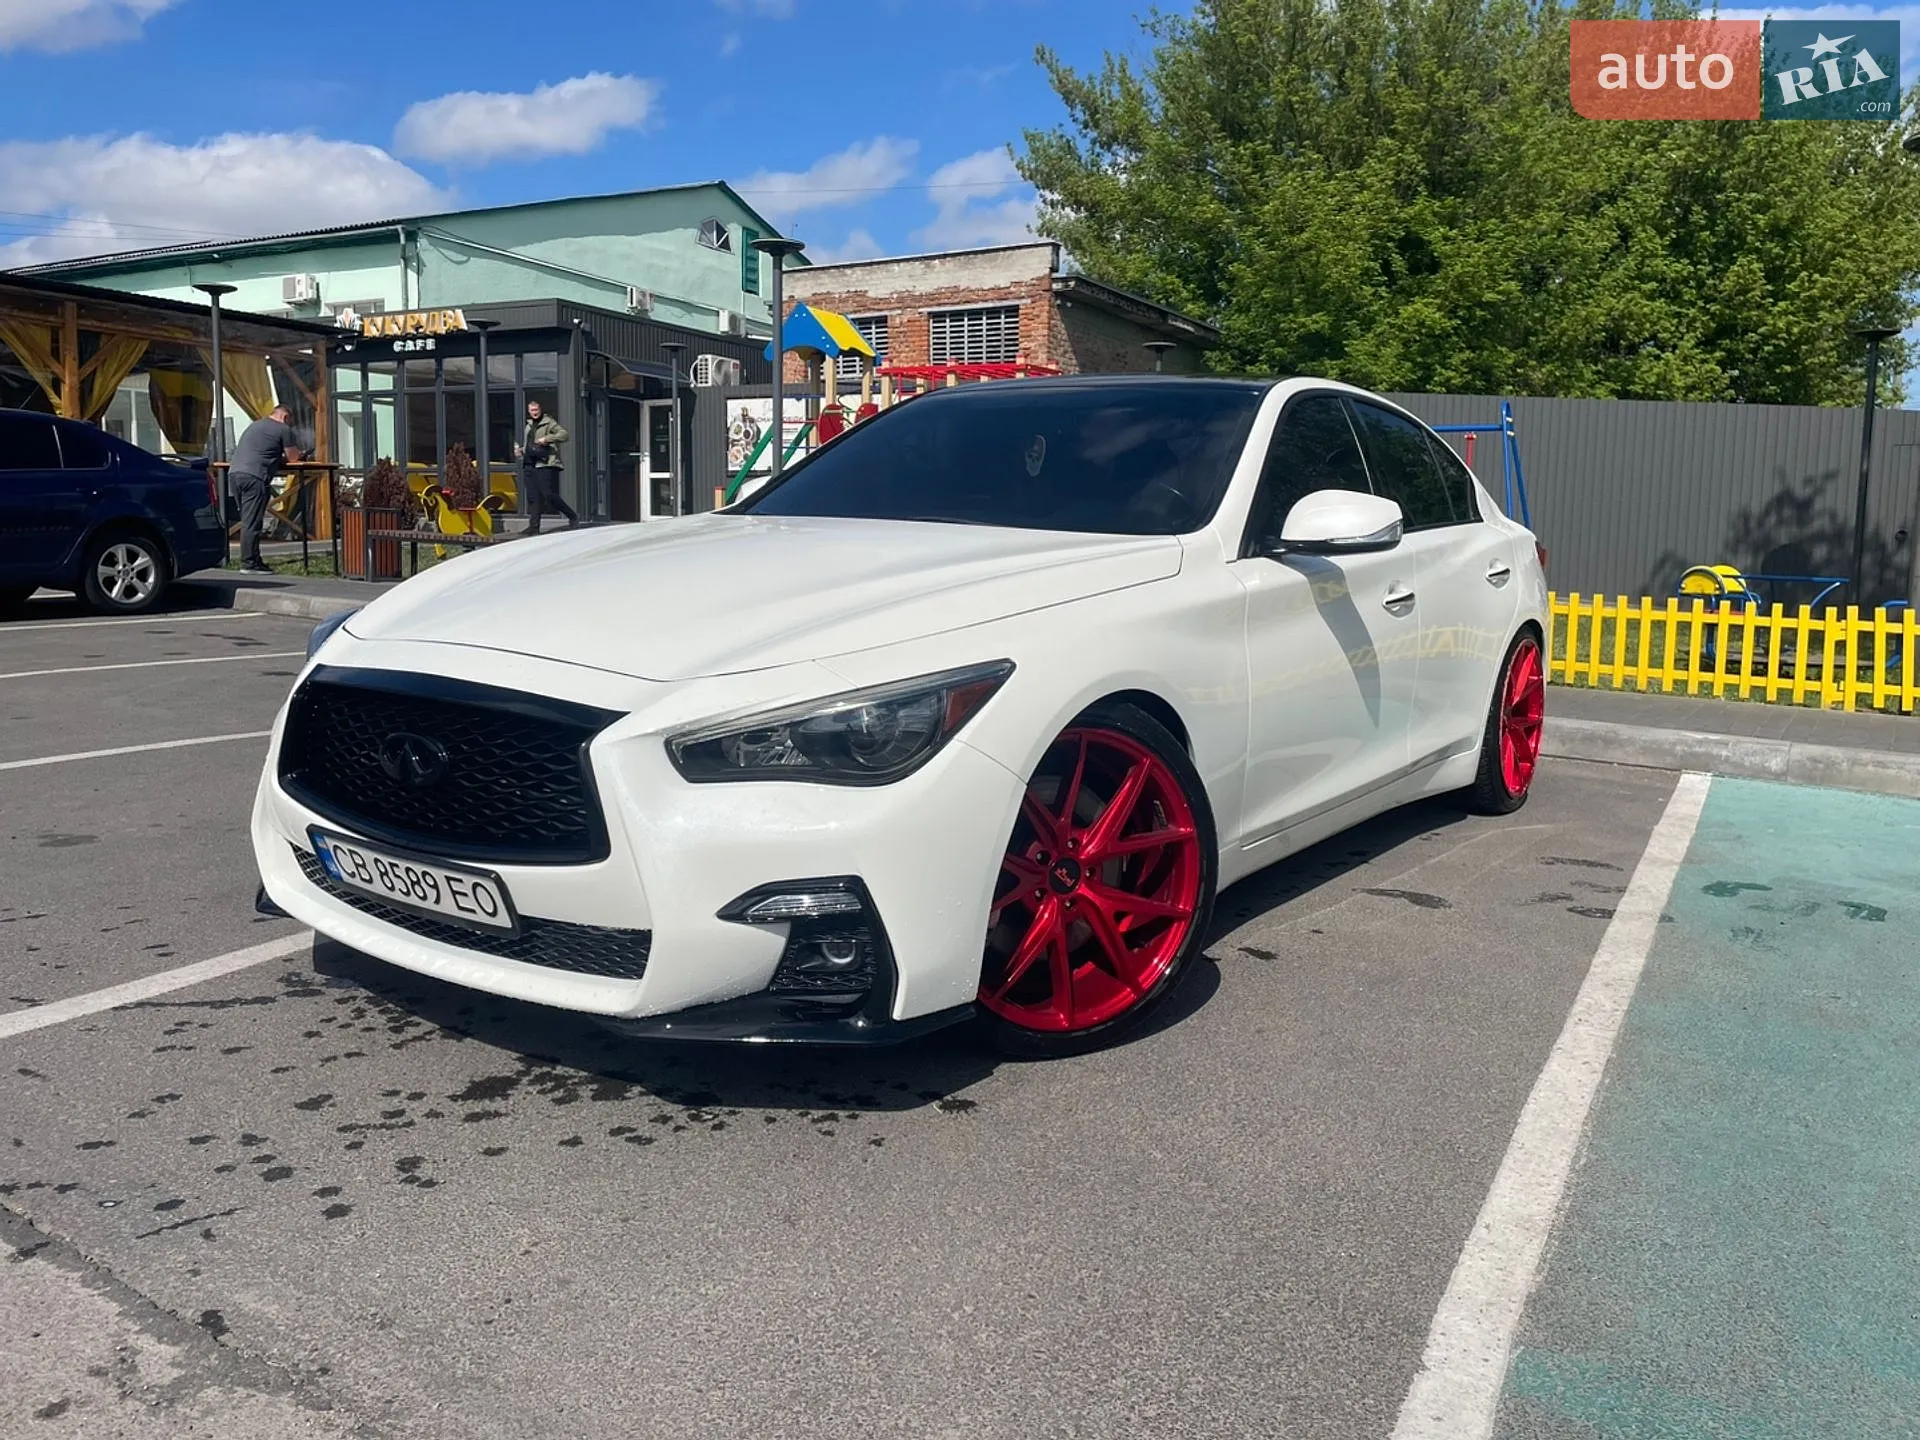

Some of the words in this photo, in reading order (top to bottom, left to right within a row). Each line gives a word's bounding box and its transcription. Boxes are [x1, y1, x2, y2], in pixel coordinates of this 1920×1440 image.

[393, 338, 436, 352] CAFE
[332, 844, 374, 884] CB
[374, 857, 441, 905] 8589
[444, 875, 498, 918] EO
